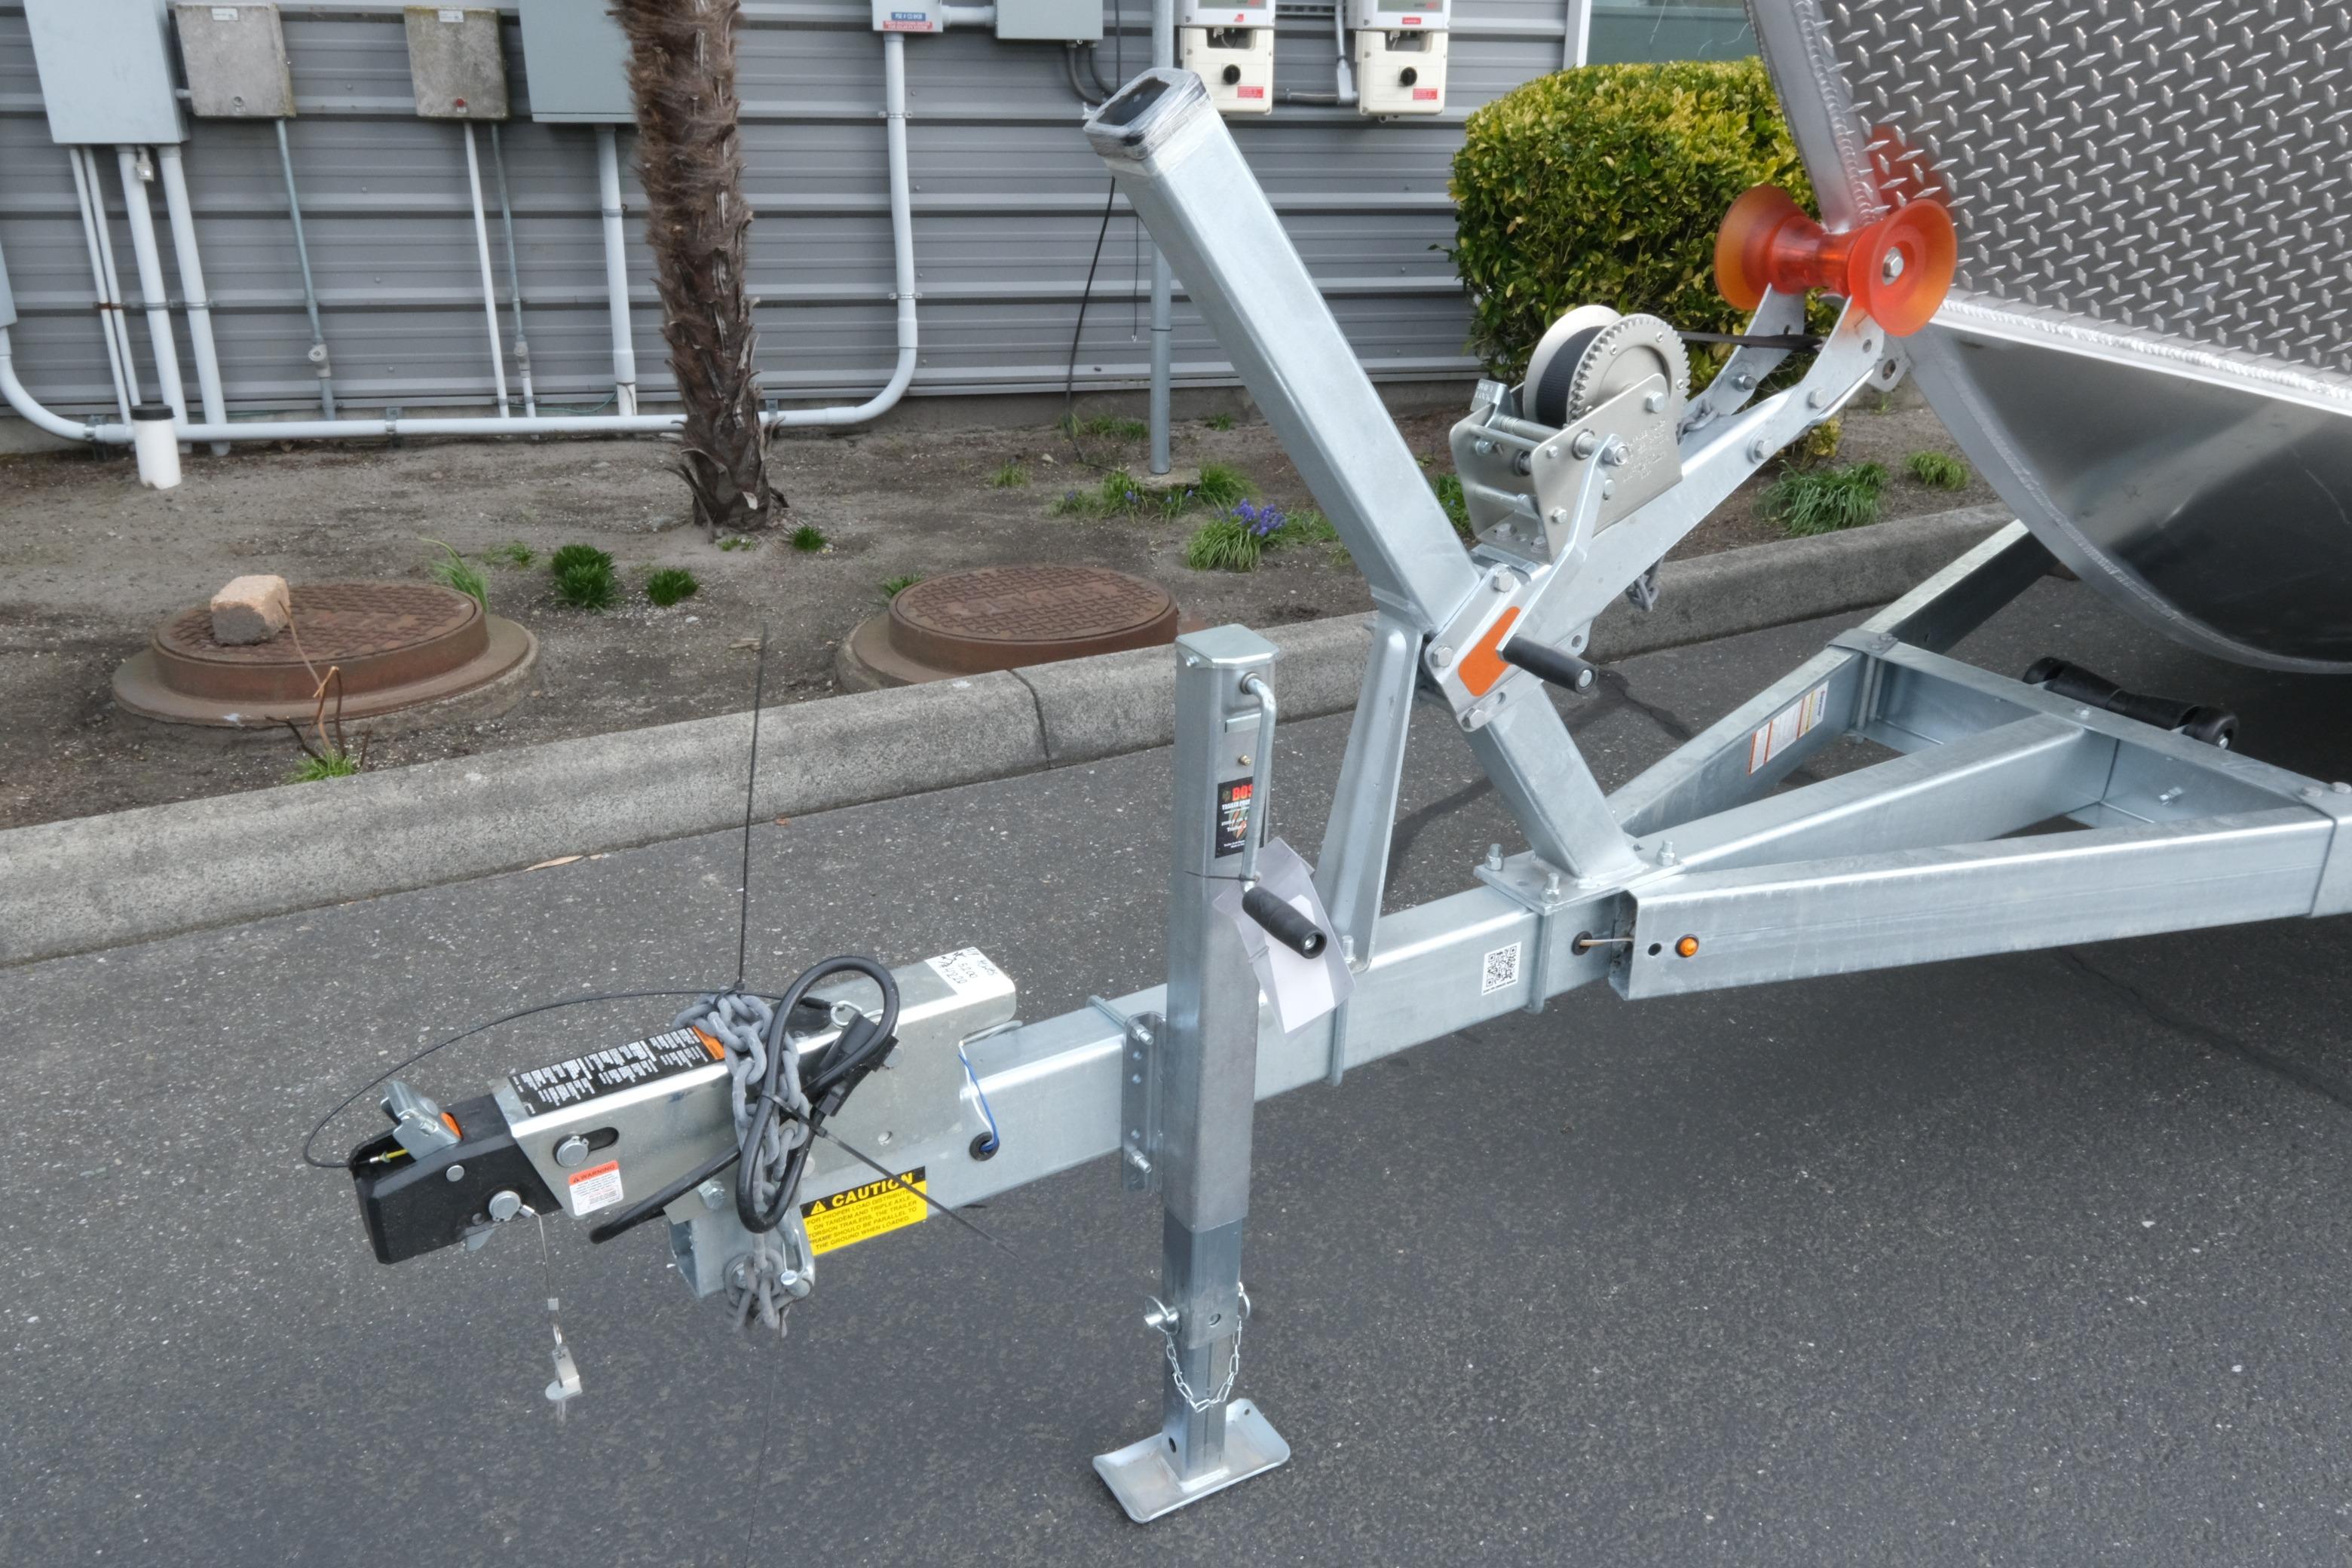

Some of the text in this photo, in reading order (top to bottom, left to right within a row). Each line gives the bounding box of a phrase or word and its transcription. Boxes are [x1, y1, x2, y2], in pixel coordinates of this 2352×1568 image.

[580, 1165, 616, 1180] WARNING
[831, 1171, 913, 1207] CAUTION
[807, 1217, 821, 1226] FOR
[822, 1208, 850, 1220] PROPER
[852, 1201, 870, 1211] LOAD
[808, 1225, 838, 1239] TORSION
[890, 1200, 917, 1211] TRAILER
[825, 1214, 853, 1227] TANDEM
[855, 1208, 868, 1217] AND
[871, 1201, 893, 1211] TRIPLE
[895, 1195, 911, 1205] AXLE
[833, 1225, 861, 1238] SHOULD
[874, 1211, 906, 1225] PARALLEL
[816, 1241, 829, 1249] THE
[831, 1232, 860, 1245] GROUND
[861, 1225, 880, 1235] WHEN
